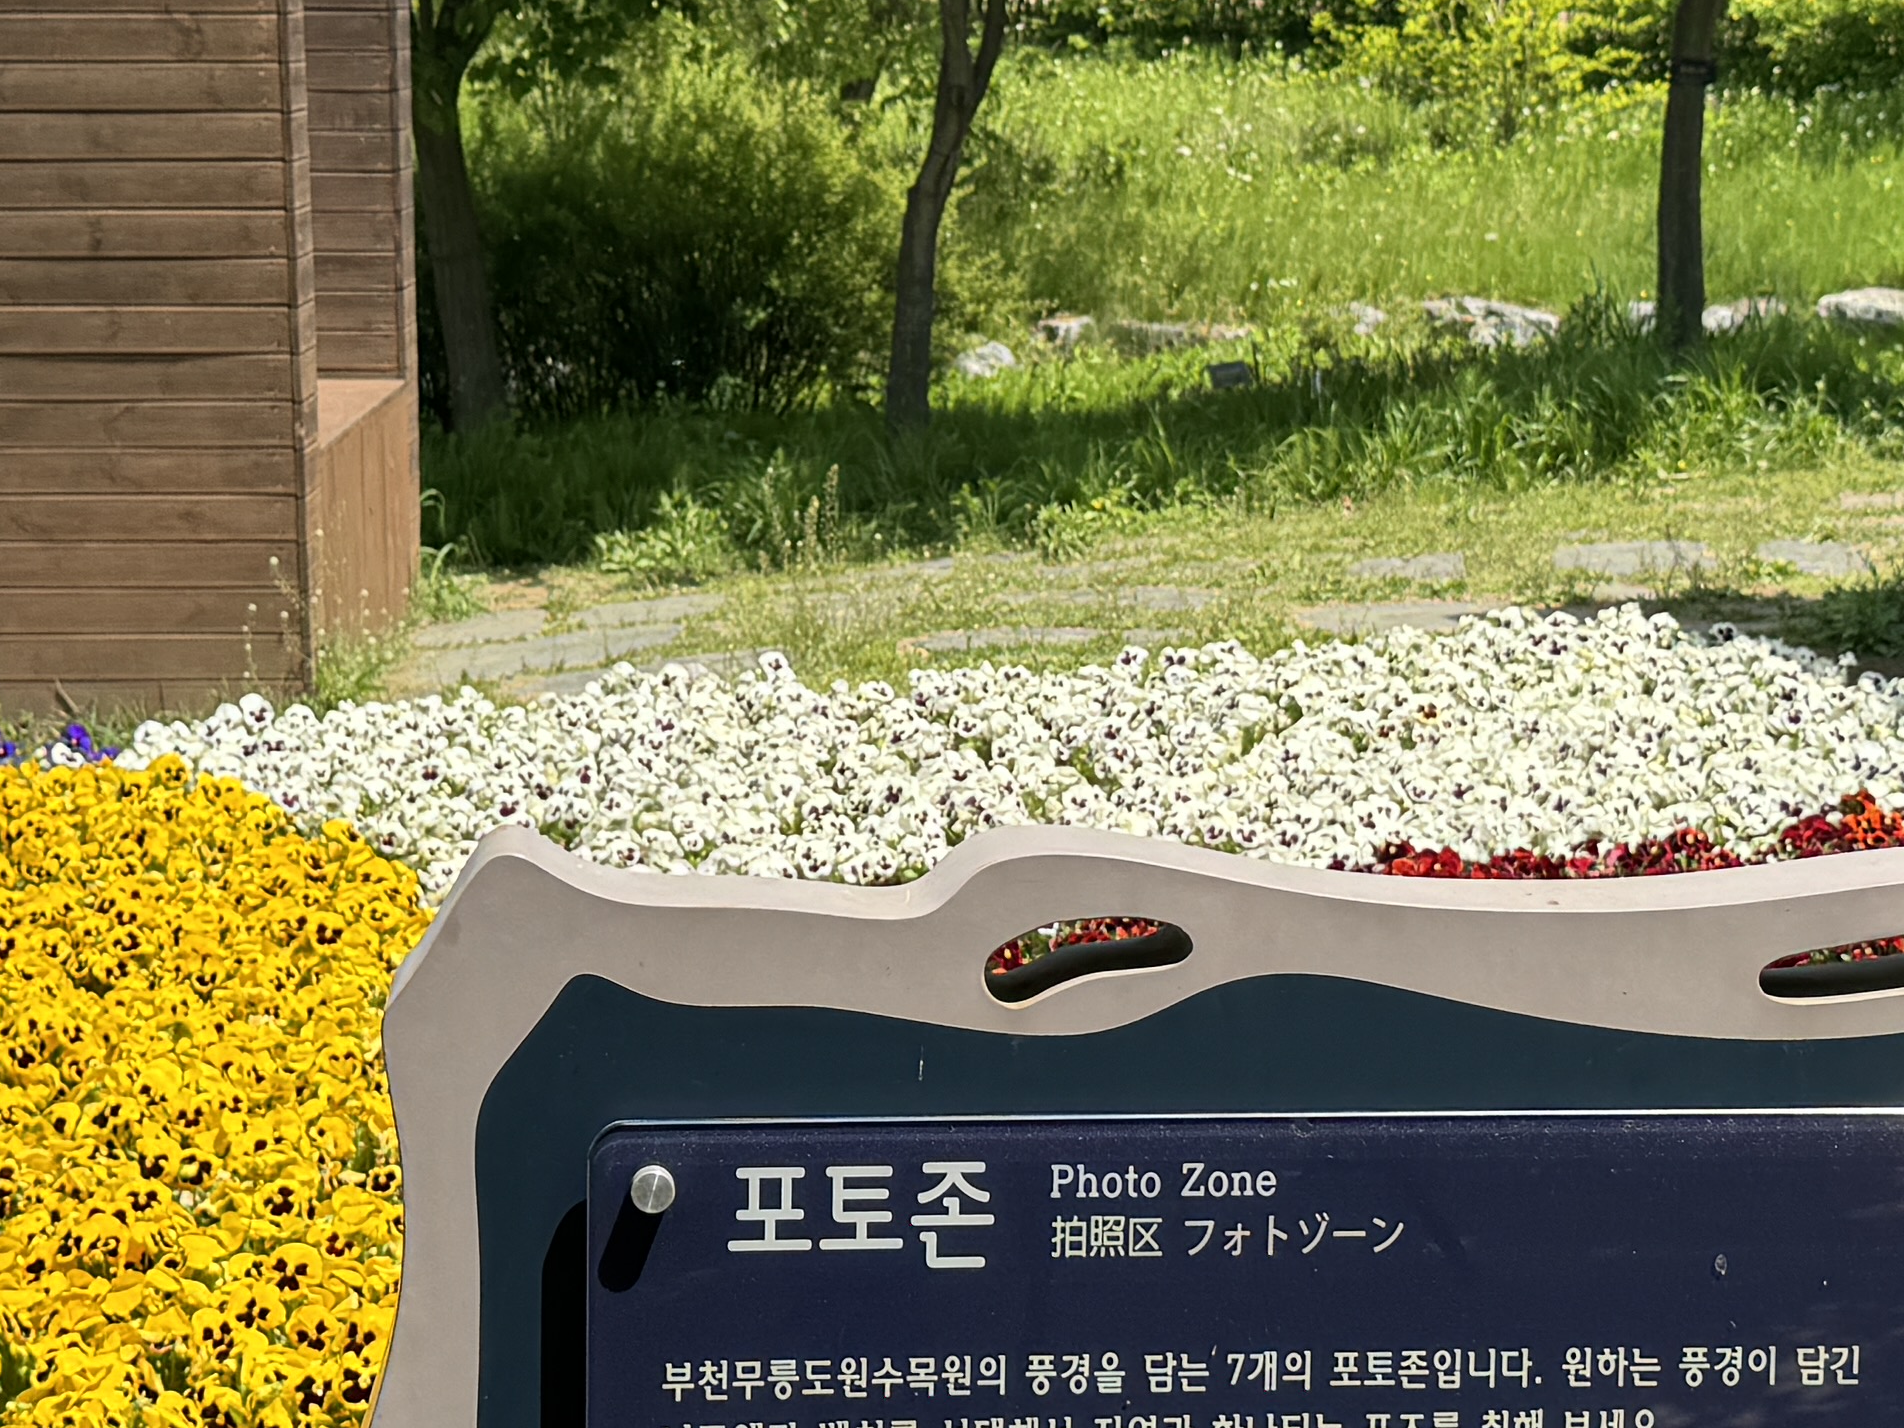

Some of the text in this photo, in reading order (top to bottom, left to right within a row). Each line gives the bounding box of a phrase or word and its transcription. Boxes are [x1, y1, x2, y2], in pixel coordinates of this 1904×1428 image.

[1050, 1162, 1277, 1199] Photo Zone
[727, 1161, 995, 1269] 포토존
[1051, 1215, 1163, 1258] 拍照区
[1184, 1212, 1404, 1256] フォトゾーン
[661, 1345, 1860, 1402] 부천무릉도원수목원의 풍경을 담는 7개의 포토존입니다. 원하는 풍경이 담긴
